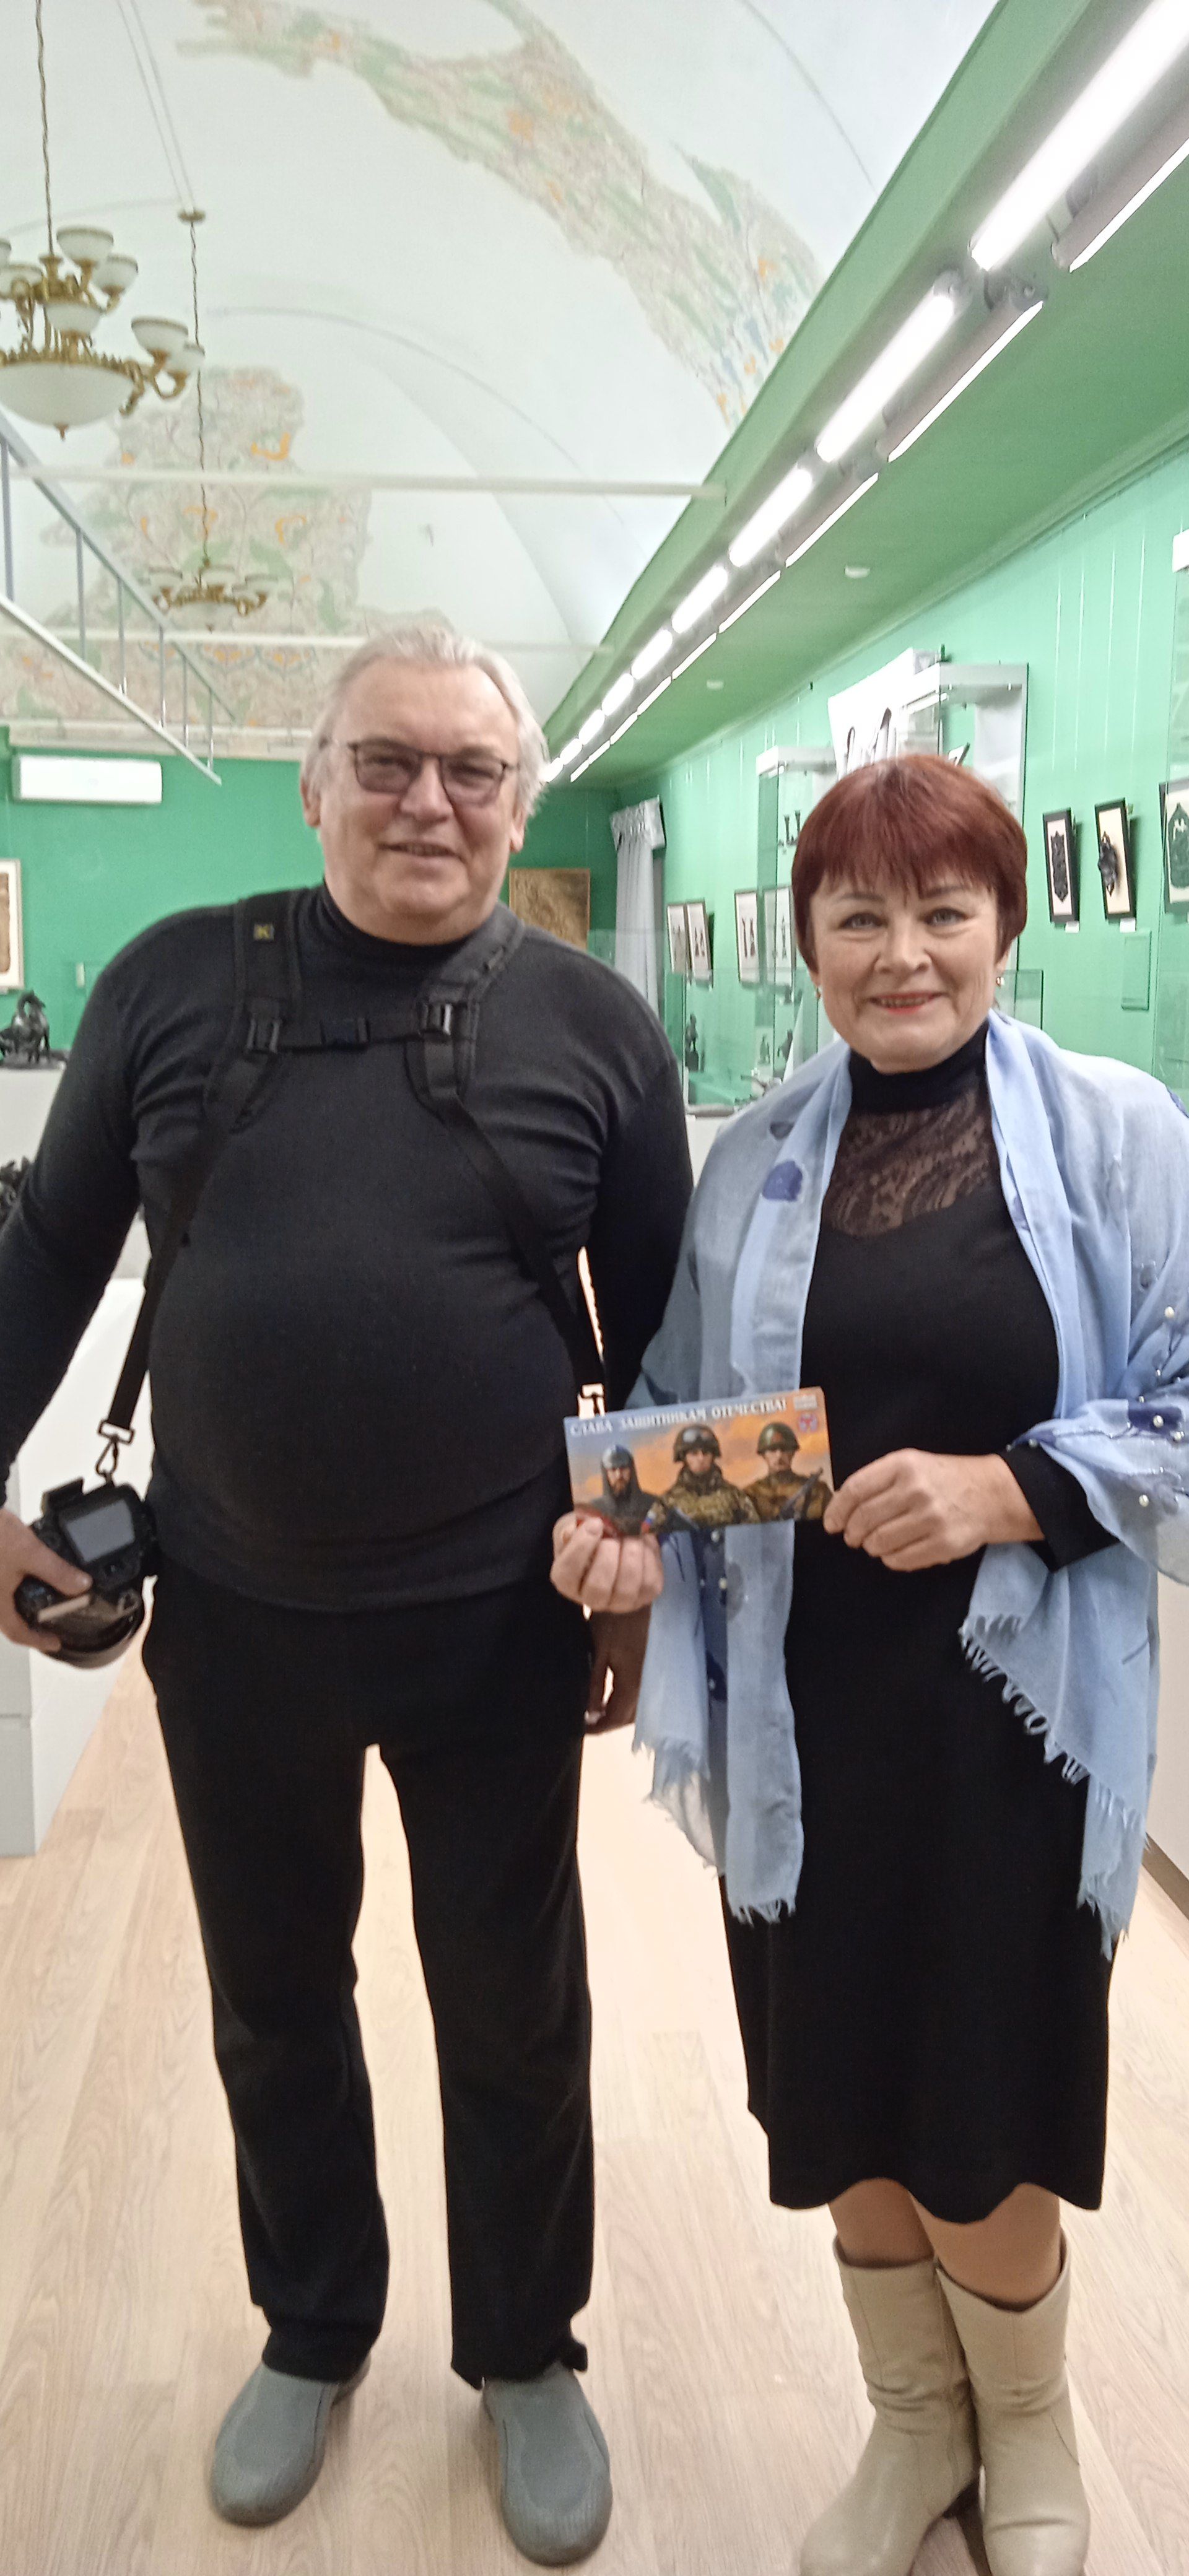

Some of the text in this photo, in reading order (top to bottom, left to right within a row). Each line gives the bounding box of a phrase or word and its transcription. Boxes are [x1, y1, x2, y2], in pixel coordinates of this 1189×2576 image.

[569, 1419, 613, 1436] СЛАВА
[621, 1406, 707, 1429] ЗАЩИТНИКАМ
[712, 1396, 787, 1420] ОТЕЧЕСТВА!
